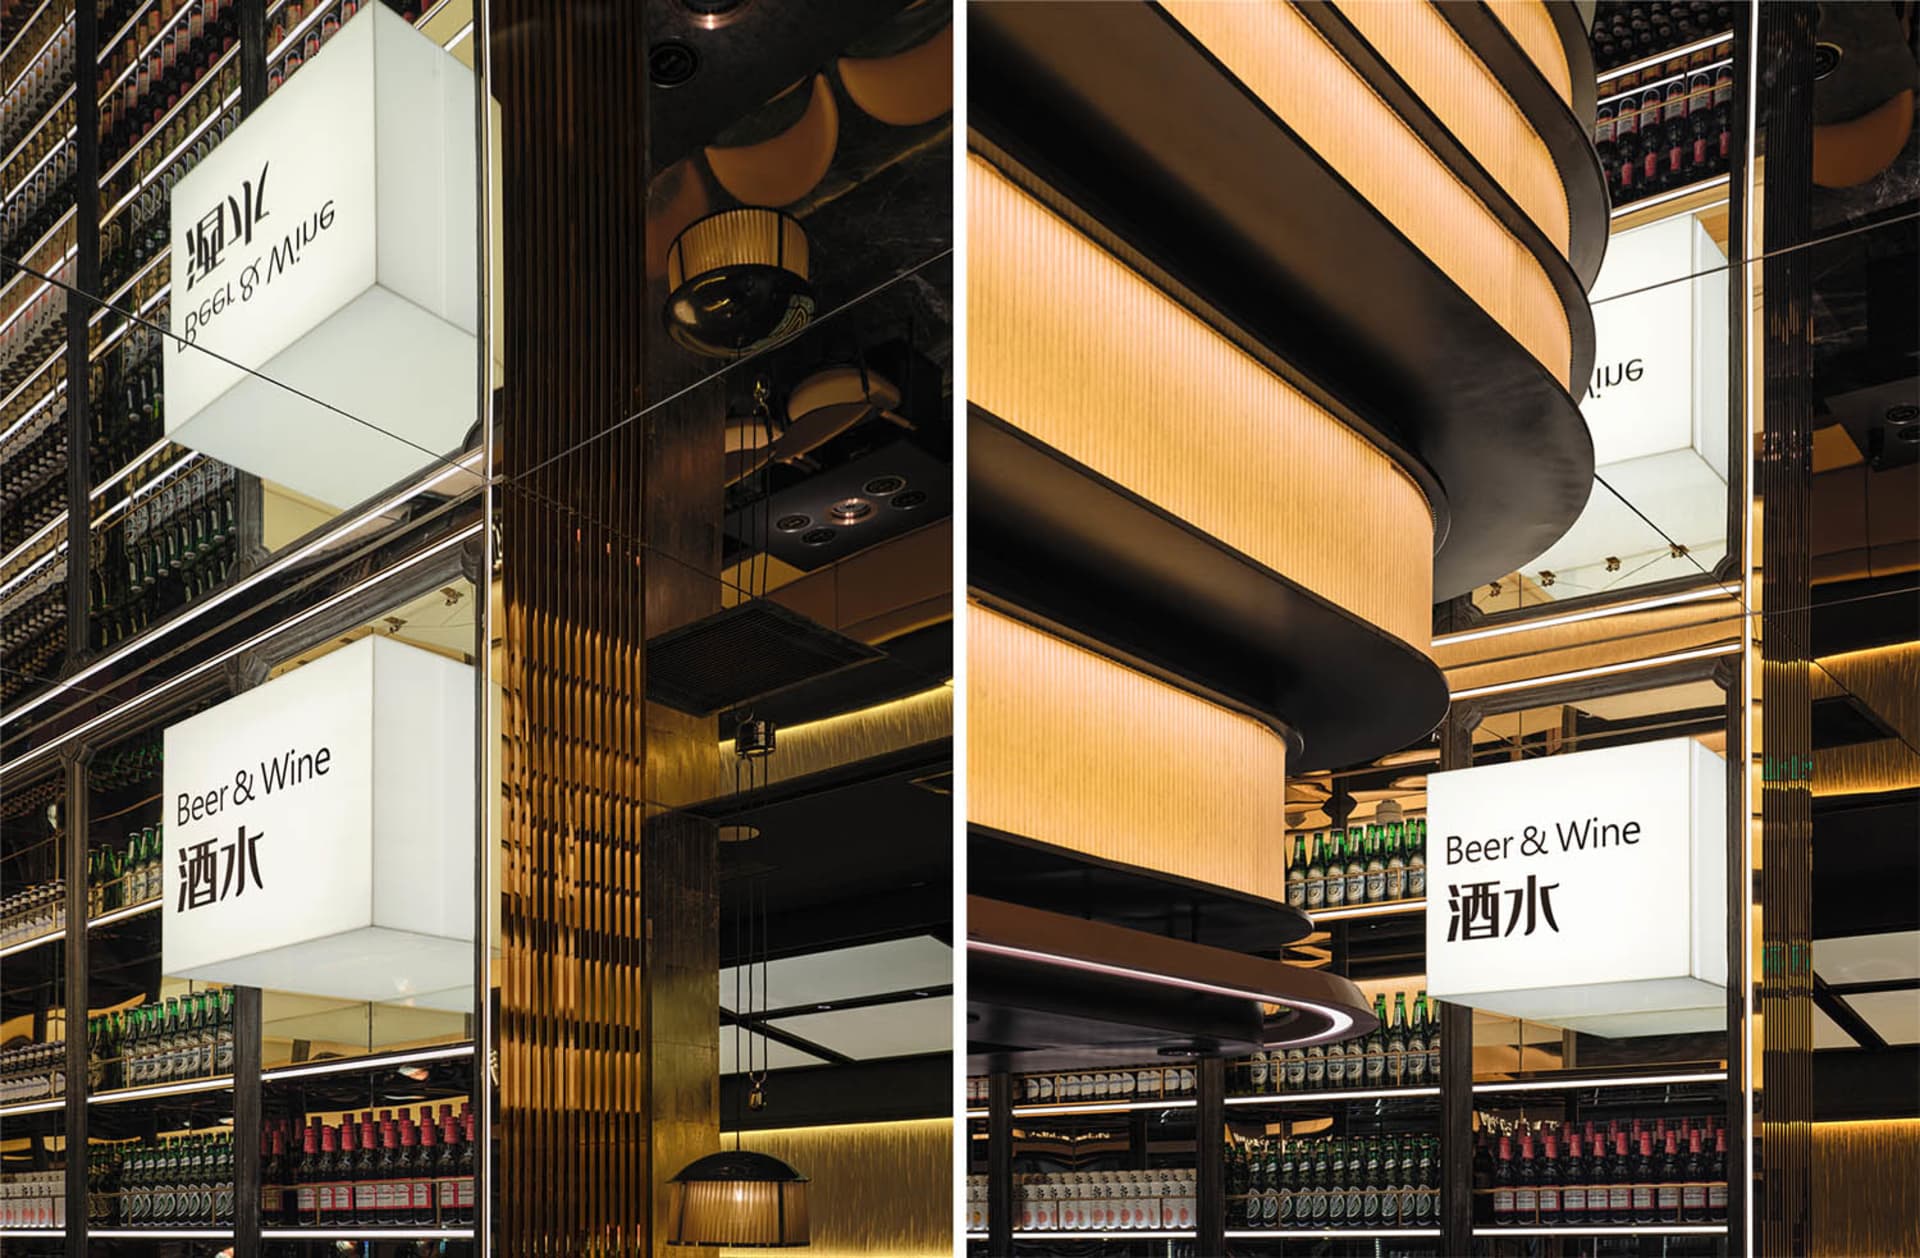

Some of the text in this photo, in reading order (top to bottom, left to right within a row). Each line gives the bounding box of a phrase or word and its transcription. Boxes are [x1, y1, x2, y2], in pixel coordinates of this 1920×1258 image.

[177, 747, 331, 827] Beer & Wine
[177, 825, 265, 913] 酒水
[1446, 816, 1641, 865] Beer & Wine
[1446, 874, 1560, 942] 酒水
